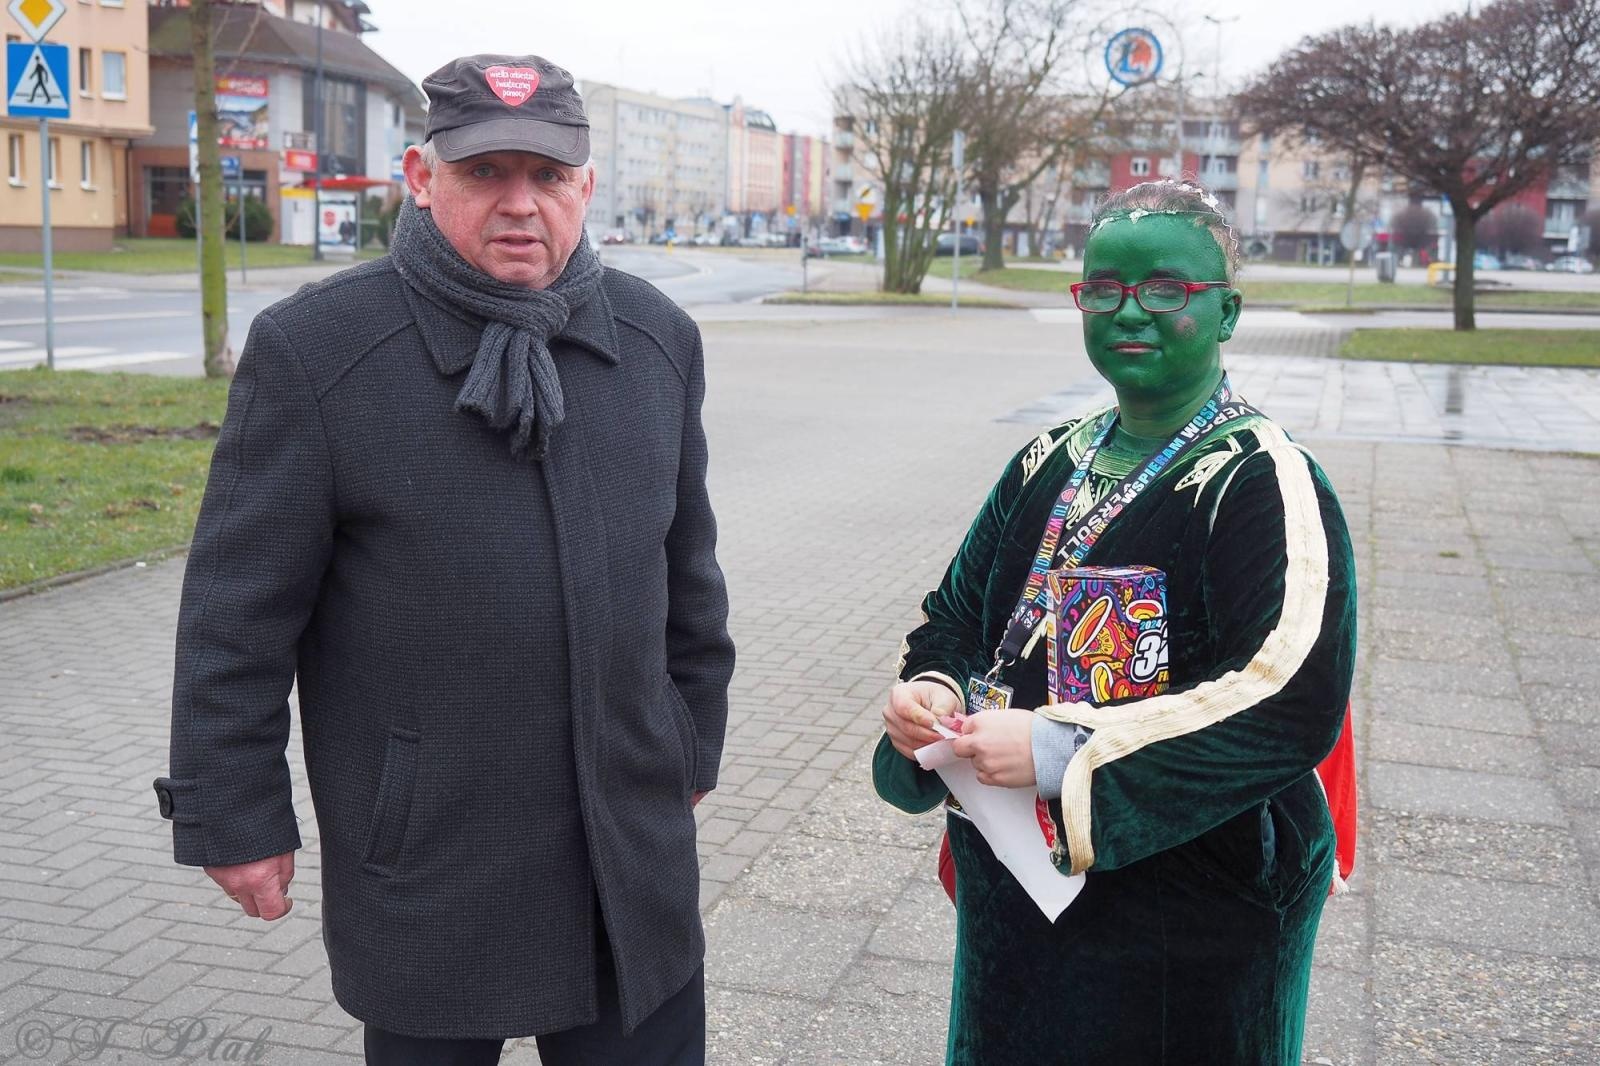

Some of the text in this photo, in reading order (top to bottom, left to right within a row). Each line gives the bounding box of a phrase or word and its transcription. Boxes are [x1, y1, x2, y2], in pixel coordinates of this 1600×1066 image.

[1121, 437, 1186, 504] WSPIERAM
[1053, 504, 1069, 519] TU
[1035, 518, 1064, 567] WSZYSTKO
[1028, 567, 1047, 586] GRA
[1140, 619, 1162, 631] 2024
